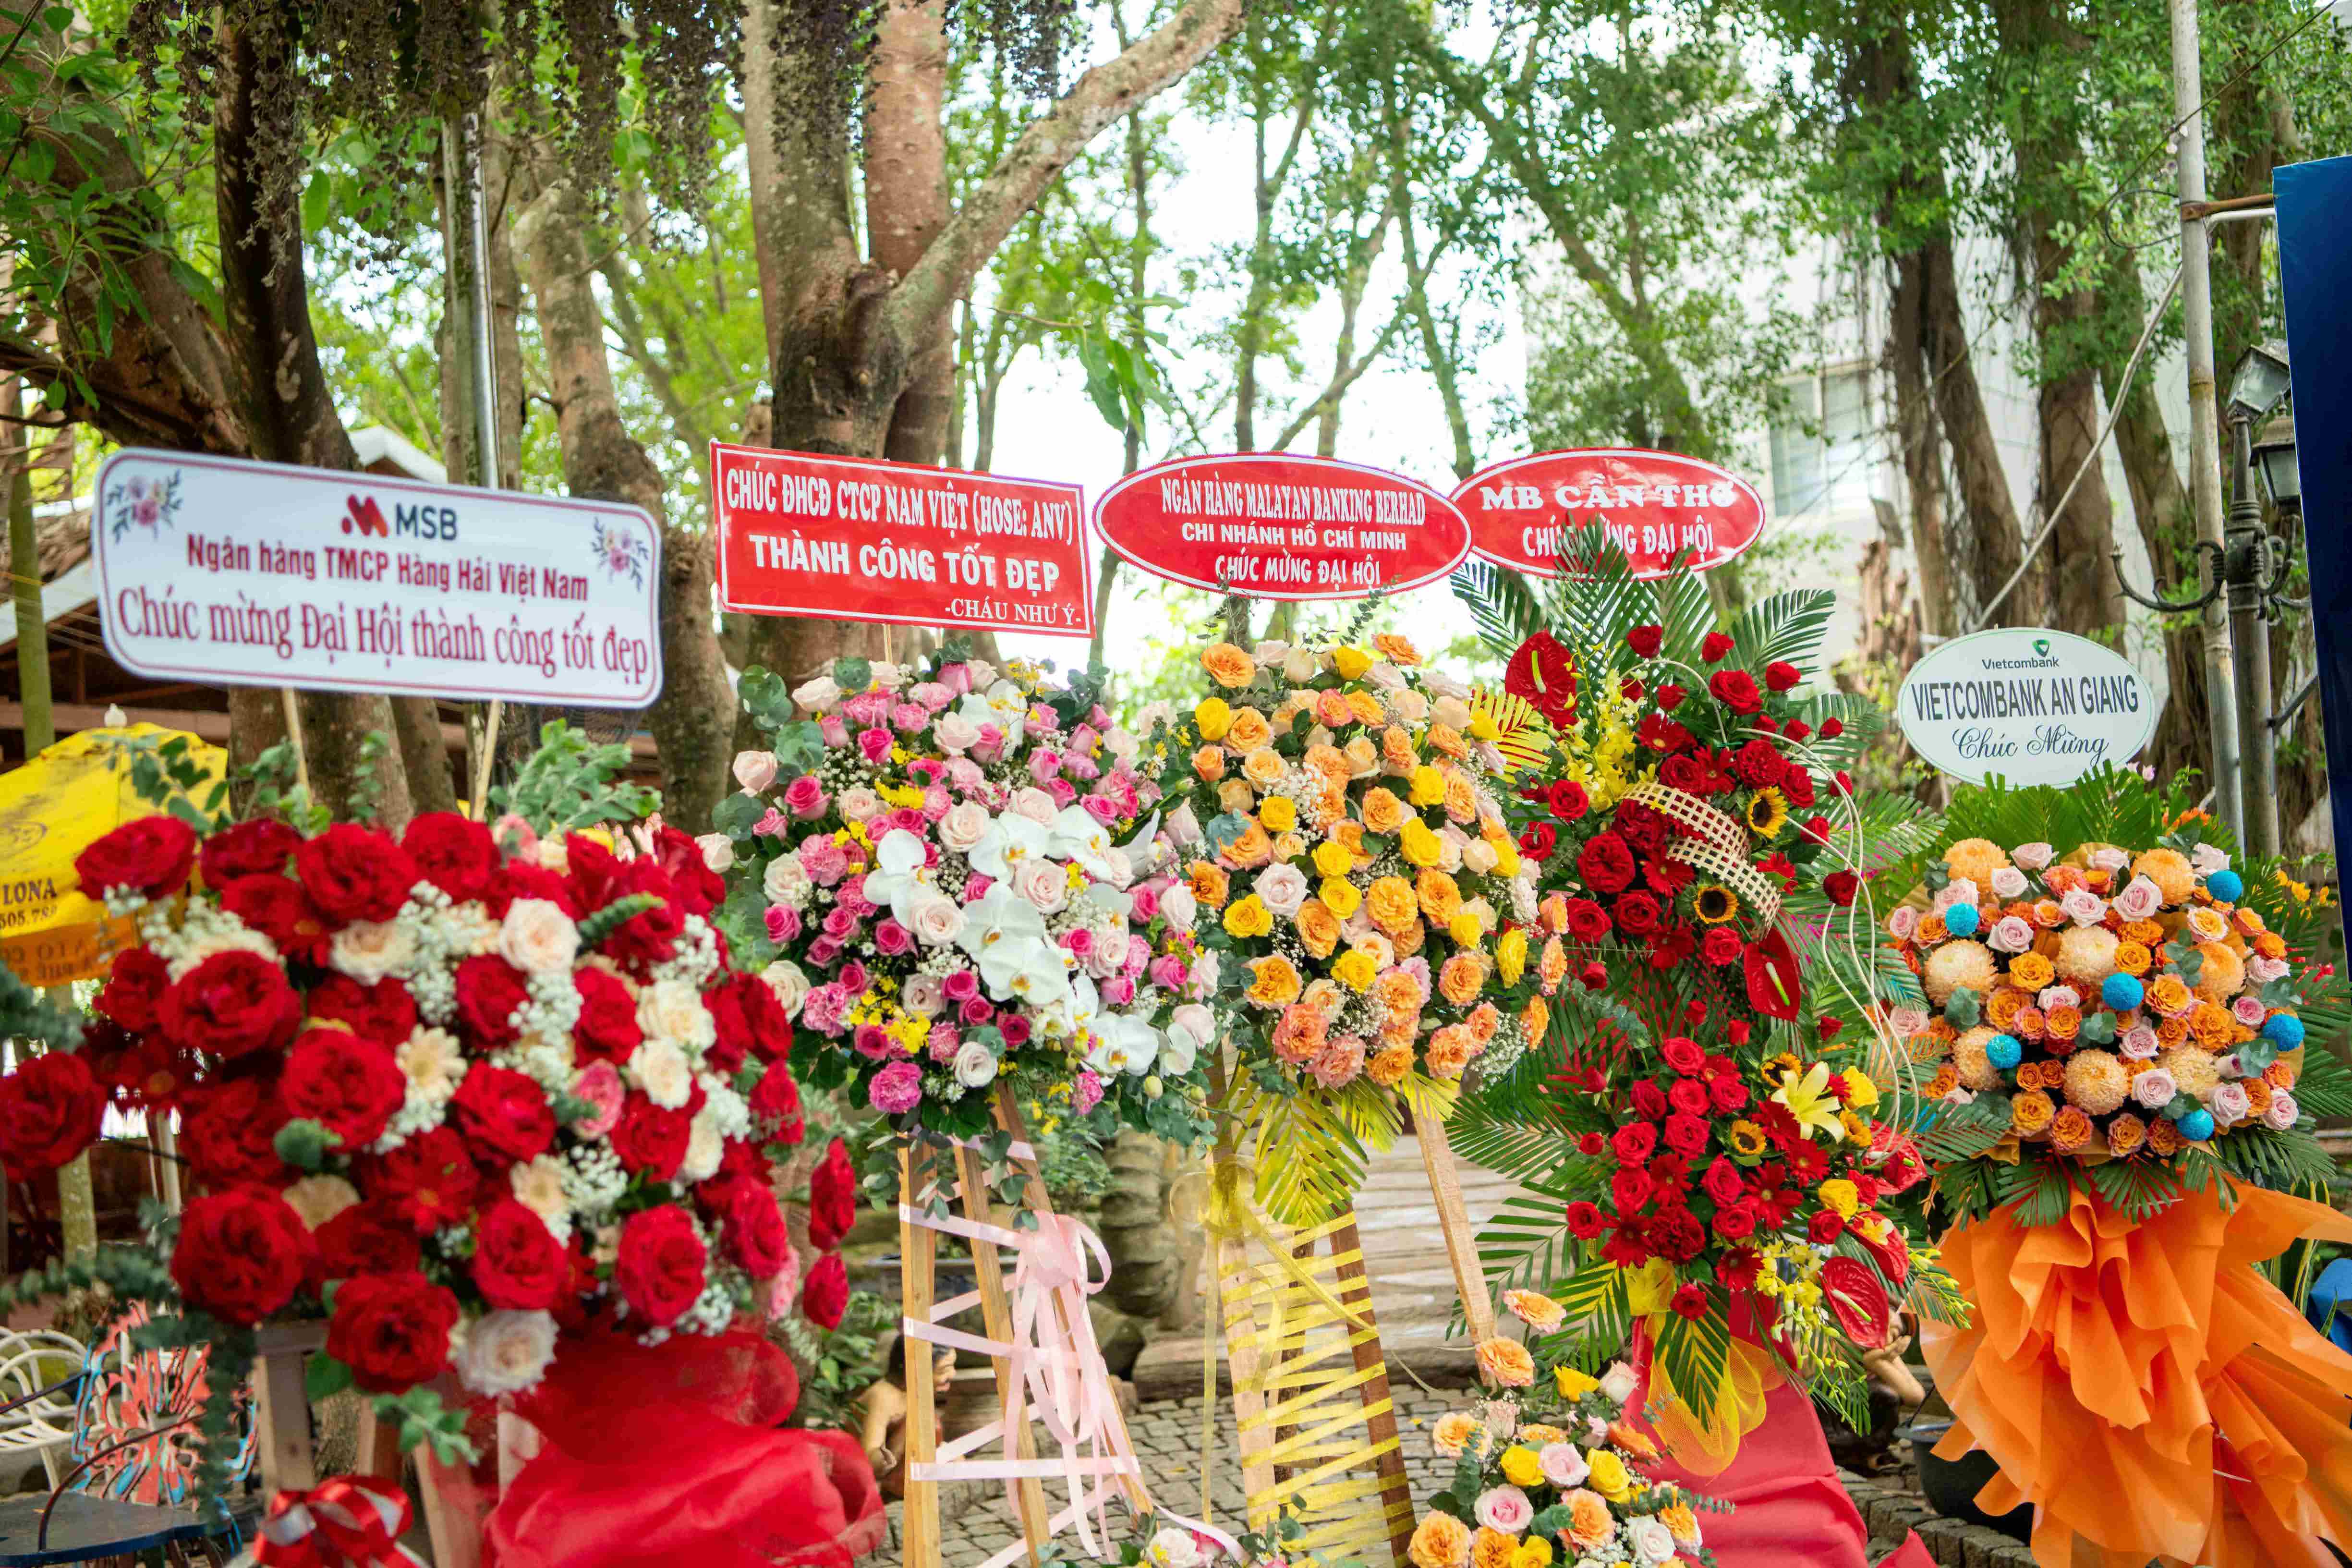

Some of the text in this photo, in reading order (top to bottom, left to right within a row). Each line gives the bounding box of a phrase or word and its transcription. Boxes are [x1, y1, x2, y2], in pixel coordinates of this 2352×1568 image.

[727, 461, 1073, 545] CHÚC ĐHCĐ CTCP NAM VIỆT (HOSE: ANV)
[1161, 469, 1425, 525] NGÂN HÀNG MALAYAN BANKING BERHAD
[1479, 473, 1738, 511] MB CẦN THƠ
[396, 502, 458, 541] MSB
[1181, 521, 1406, 550] CHI NHÁNH HỒ CHÍ MINH
[1642, 523, 1676, 563] ĐẠI
[1683, 515, 1713, 563] HỘI
[187, 534, 588, 603] Ngân hàng TMCP Hàng Hải Việt Nam
[749, 531, 1059, 596] THÀNH CÔNG TỐT ĐẸP
[1215, 547, 1380, 591] CHÚC MỪNG ĐẠI HỘI
[119, 584, 647, 684] Chúc mừng Đại Hội thành công tốt đẹp
[1013, 603, 1057, 624] NHƯ
[1982, 657, 2059, 669] Vietcombank
[1912, 674, 2138, 720] VIETCOMBANK AN GIANG
[1952, 724, 2109, 767] Chúc Mừng
